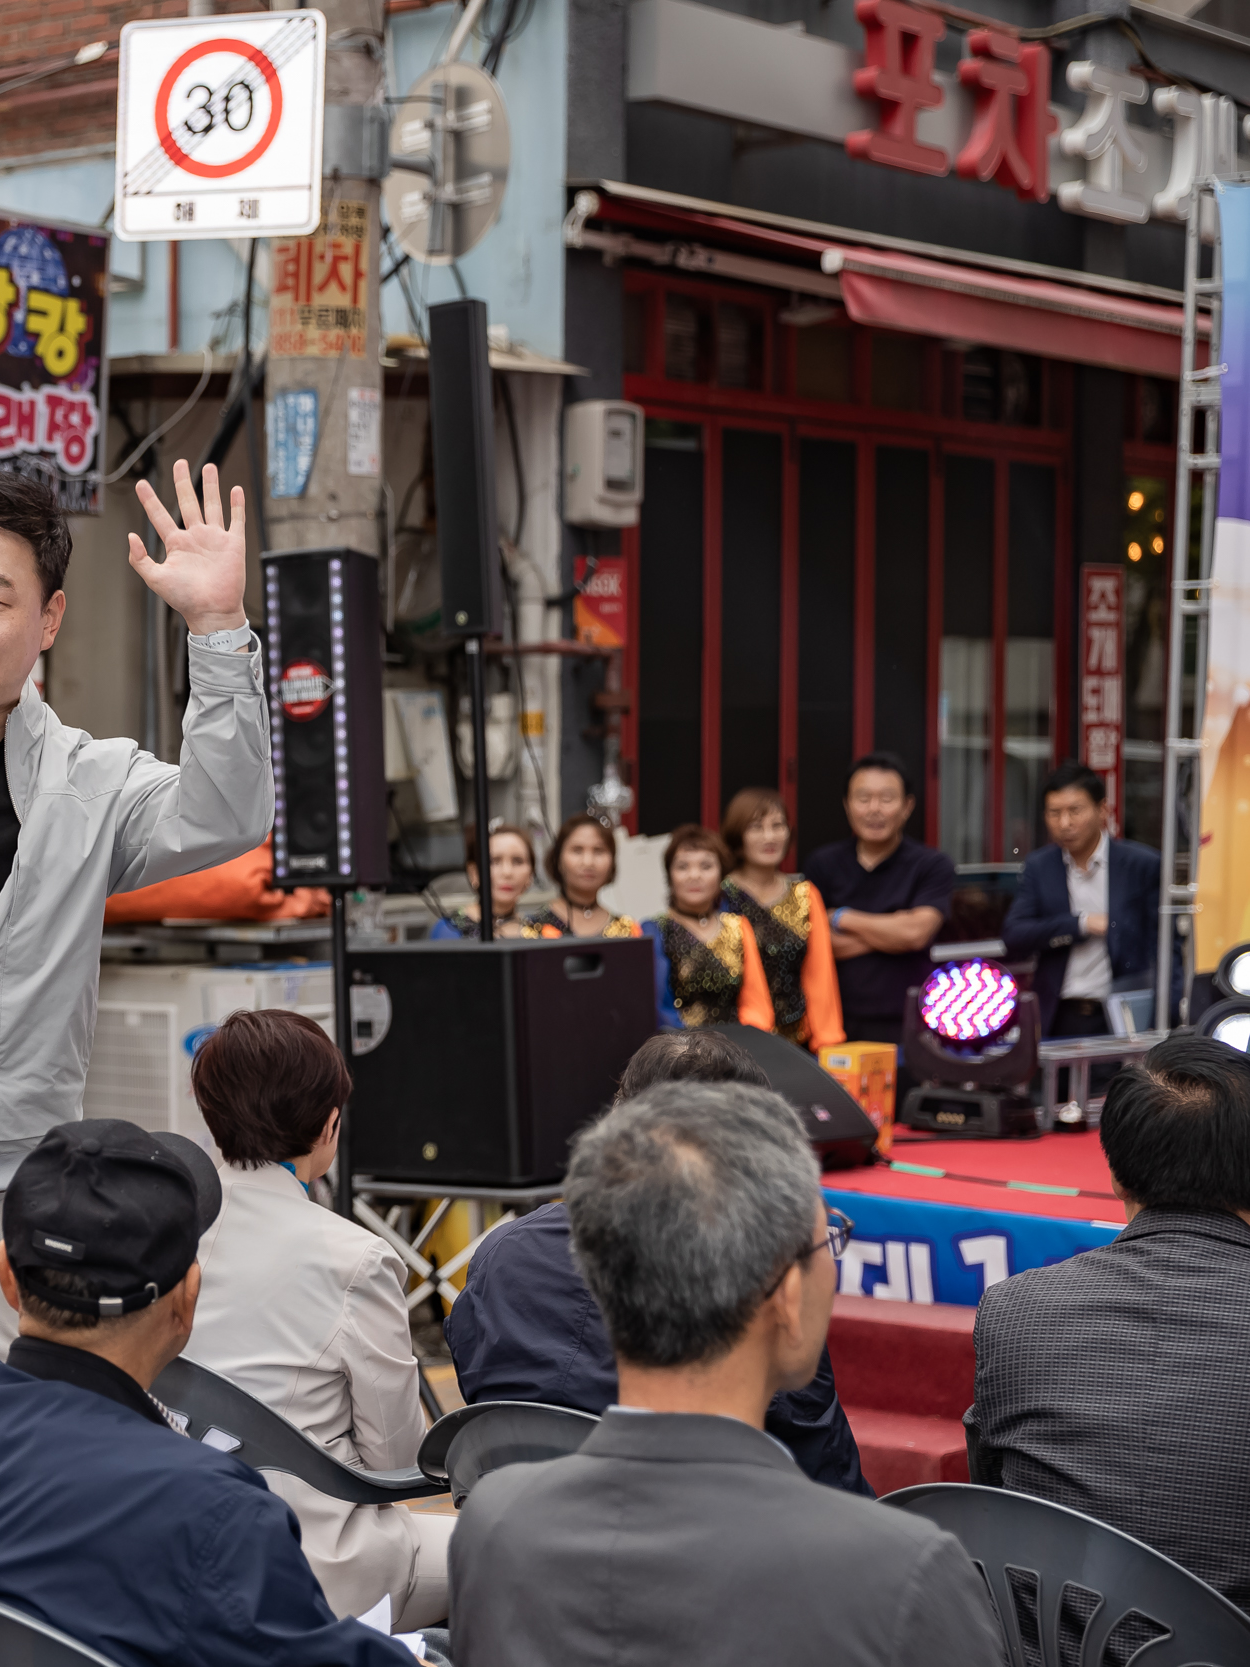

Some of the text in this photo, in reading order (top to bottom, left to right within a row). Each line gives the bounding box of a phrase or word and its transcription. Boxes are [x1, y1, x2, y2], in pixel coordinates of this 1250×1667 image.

[184, 81, 253, 135] 30
[846, 0, 1250, 246] 포차 조개
